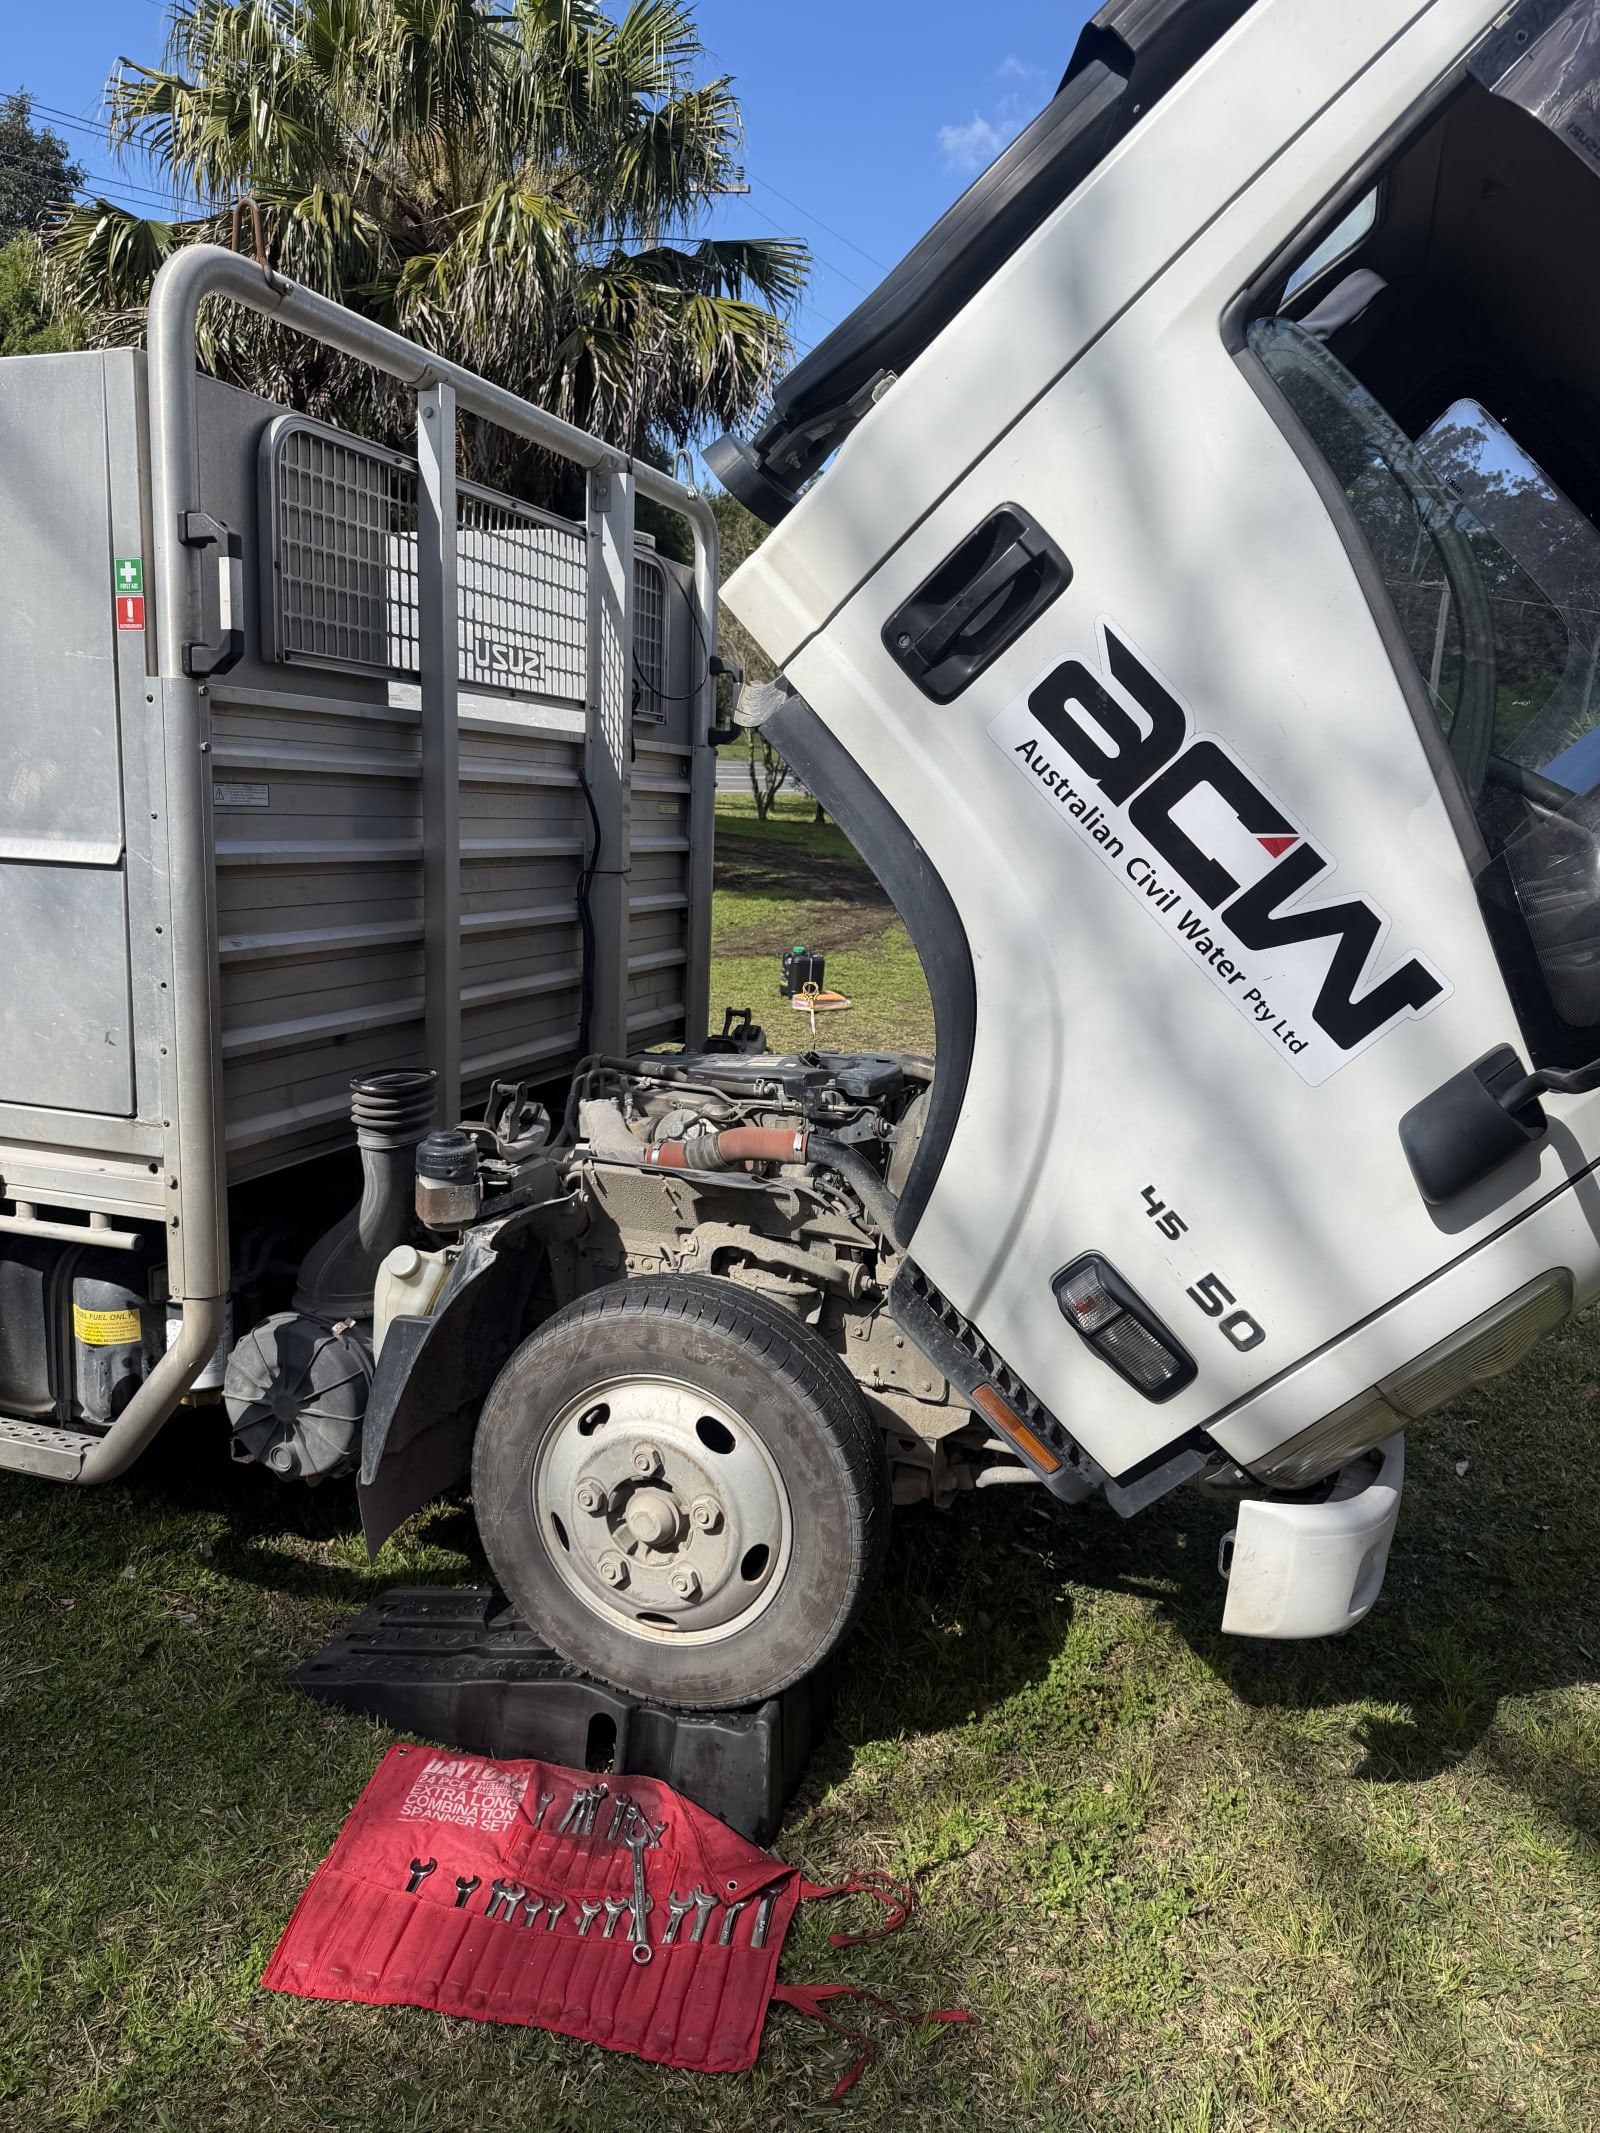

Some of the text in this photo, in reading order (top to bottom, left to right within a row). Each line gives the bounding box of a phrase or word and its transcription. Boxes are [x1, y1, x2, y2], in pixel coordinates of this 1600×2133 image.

[1015, 739, 1309, 1055] Australian Civil Water Pty Ltd
[1140, 1184, 1189, 1241] 45
[109, 1312, 132, 1320] ONLY
[1185, 1272, 1266, 1352] 50
[418, 1774, 471, 1789] 24 PCE
[405, 1794, 517, 1821] COMBINATION
[409, 1784, 519, 1810] EXTRA LONG
[400, 1804, 478, 1828] SPANNER
[479, 1819, 512, 1832] SET
